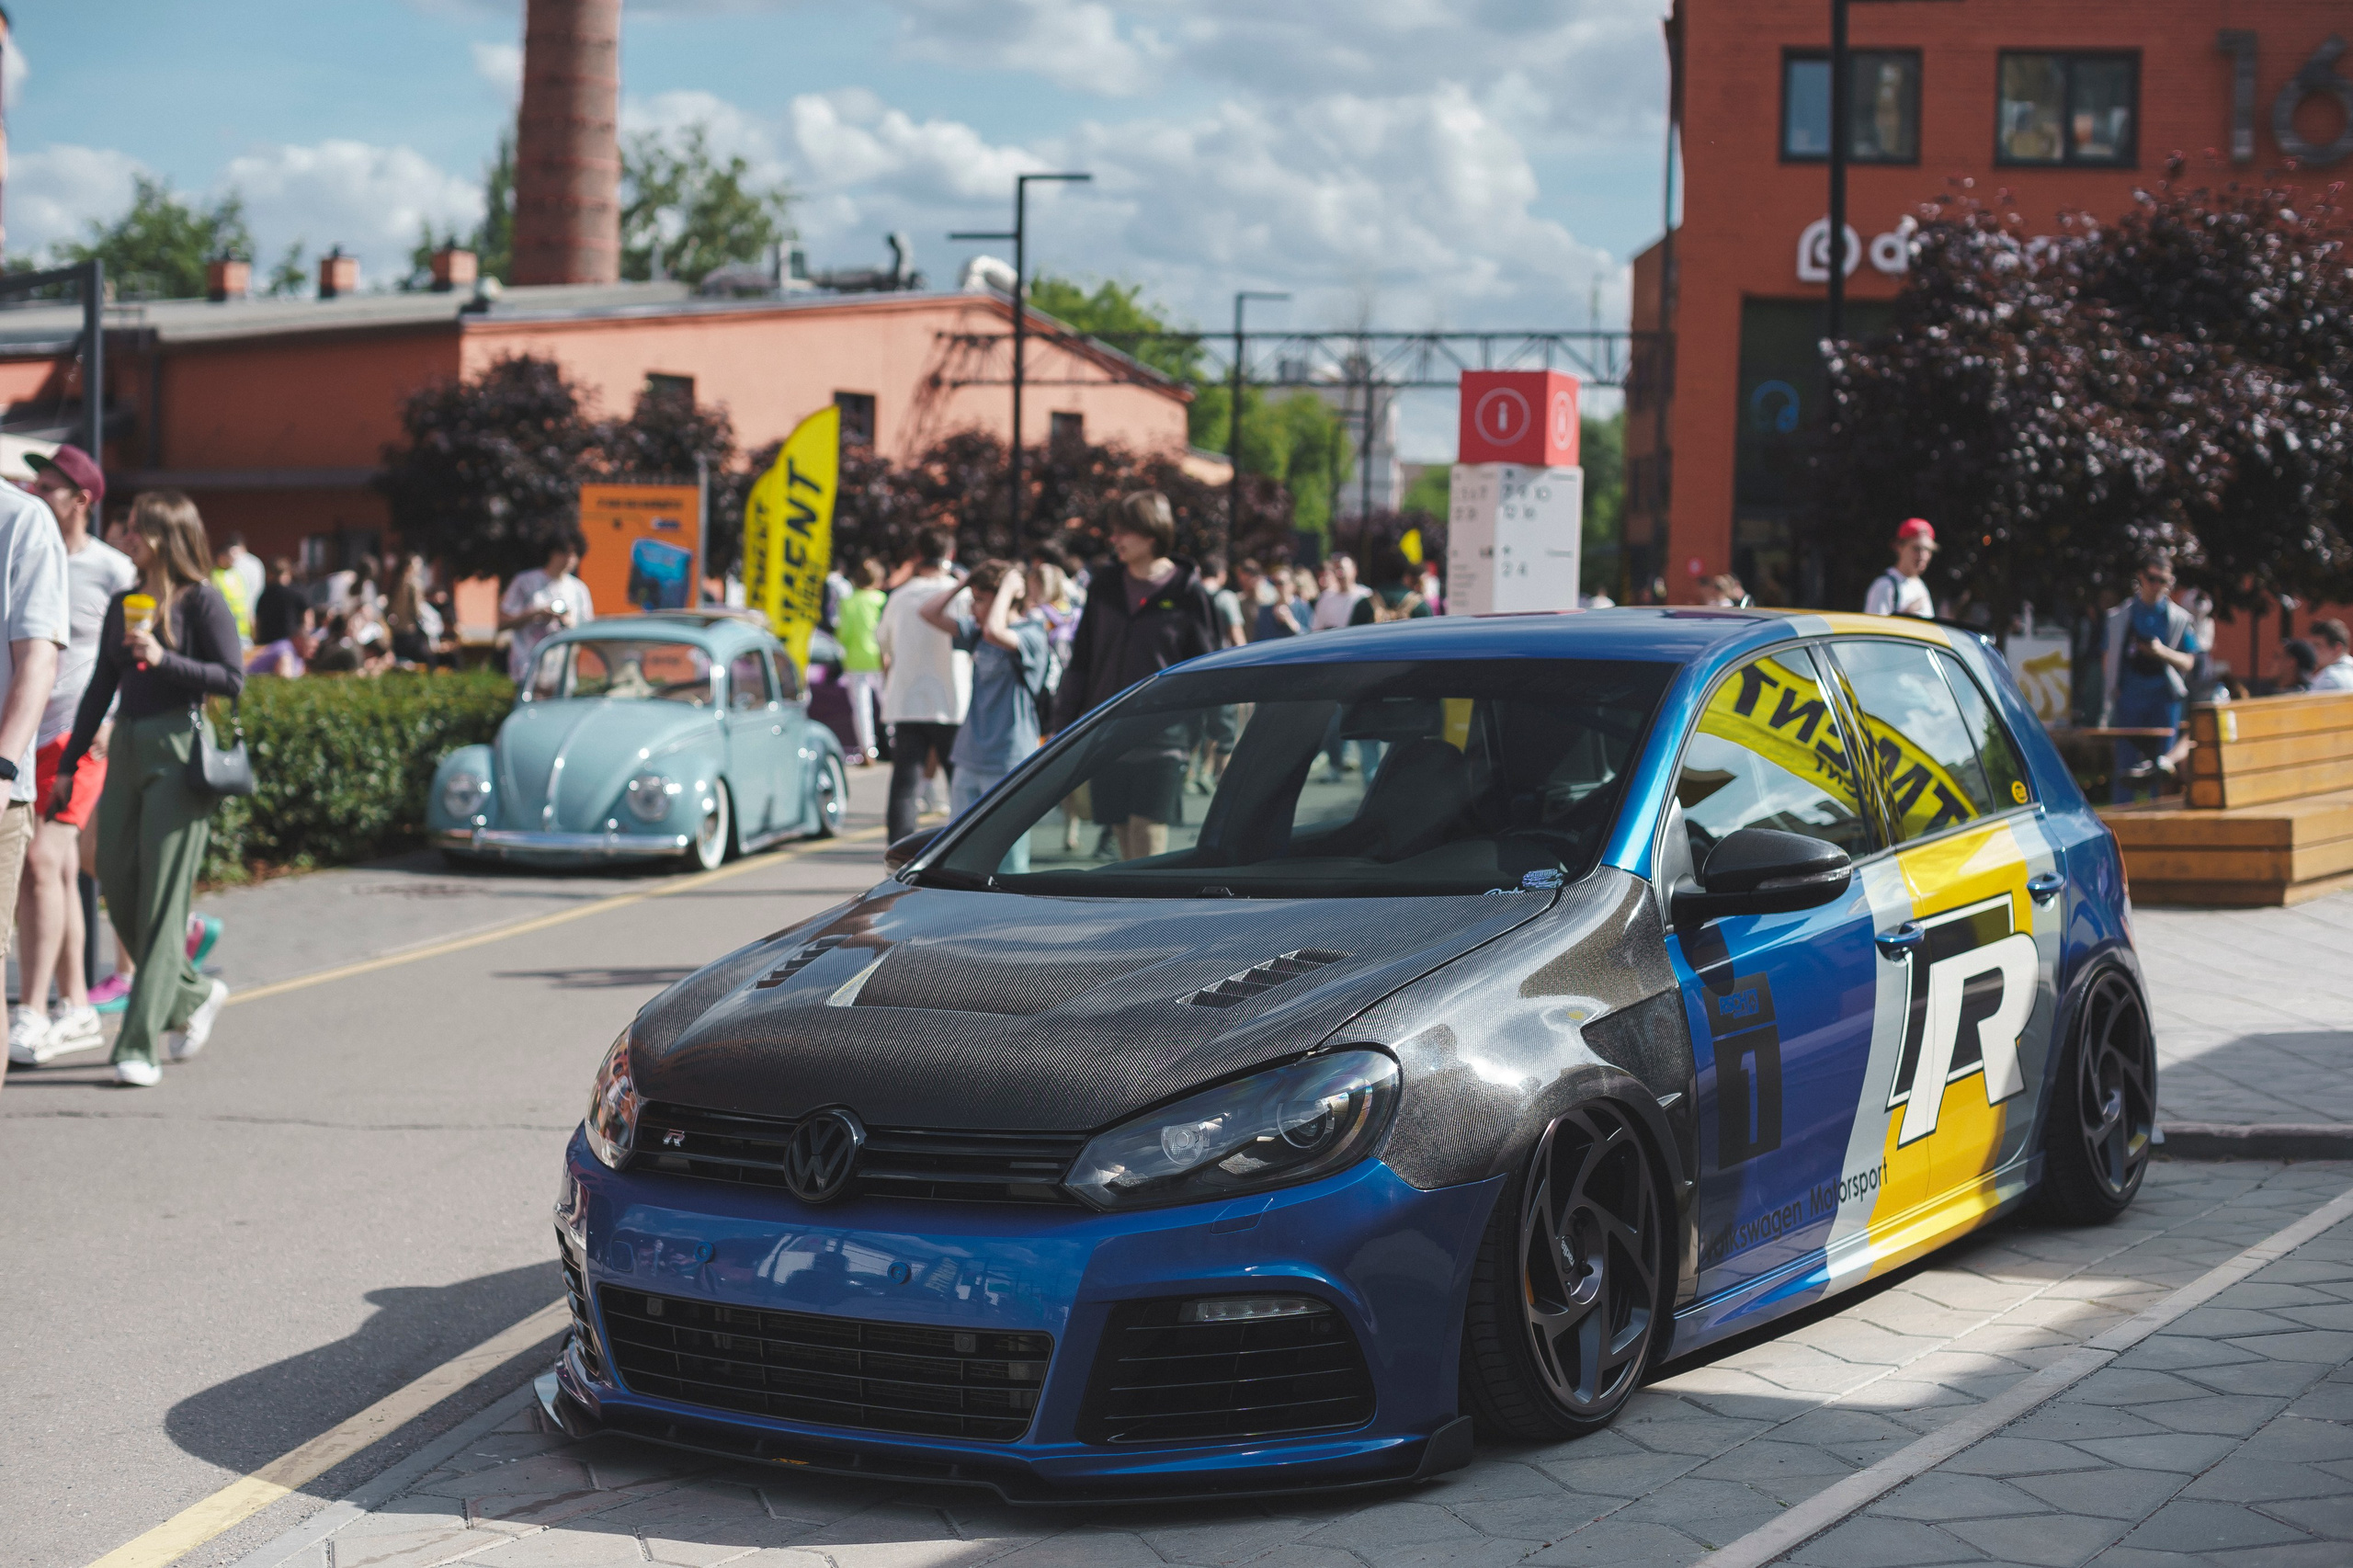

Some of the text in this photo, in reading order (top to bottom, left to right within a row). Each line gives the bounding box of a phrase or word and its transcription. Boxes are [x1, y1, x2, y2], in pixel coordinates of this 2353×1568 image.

[2217, 28, 2352, 165] 16
[1896, 931, 2040, 1151] R
[663, 1128, 686, 1147] R
[1740, 1049, 1758, 1145] 1
[1704, 1156, 1889, 1261] Volkswagen Motorsport
